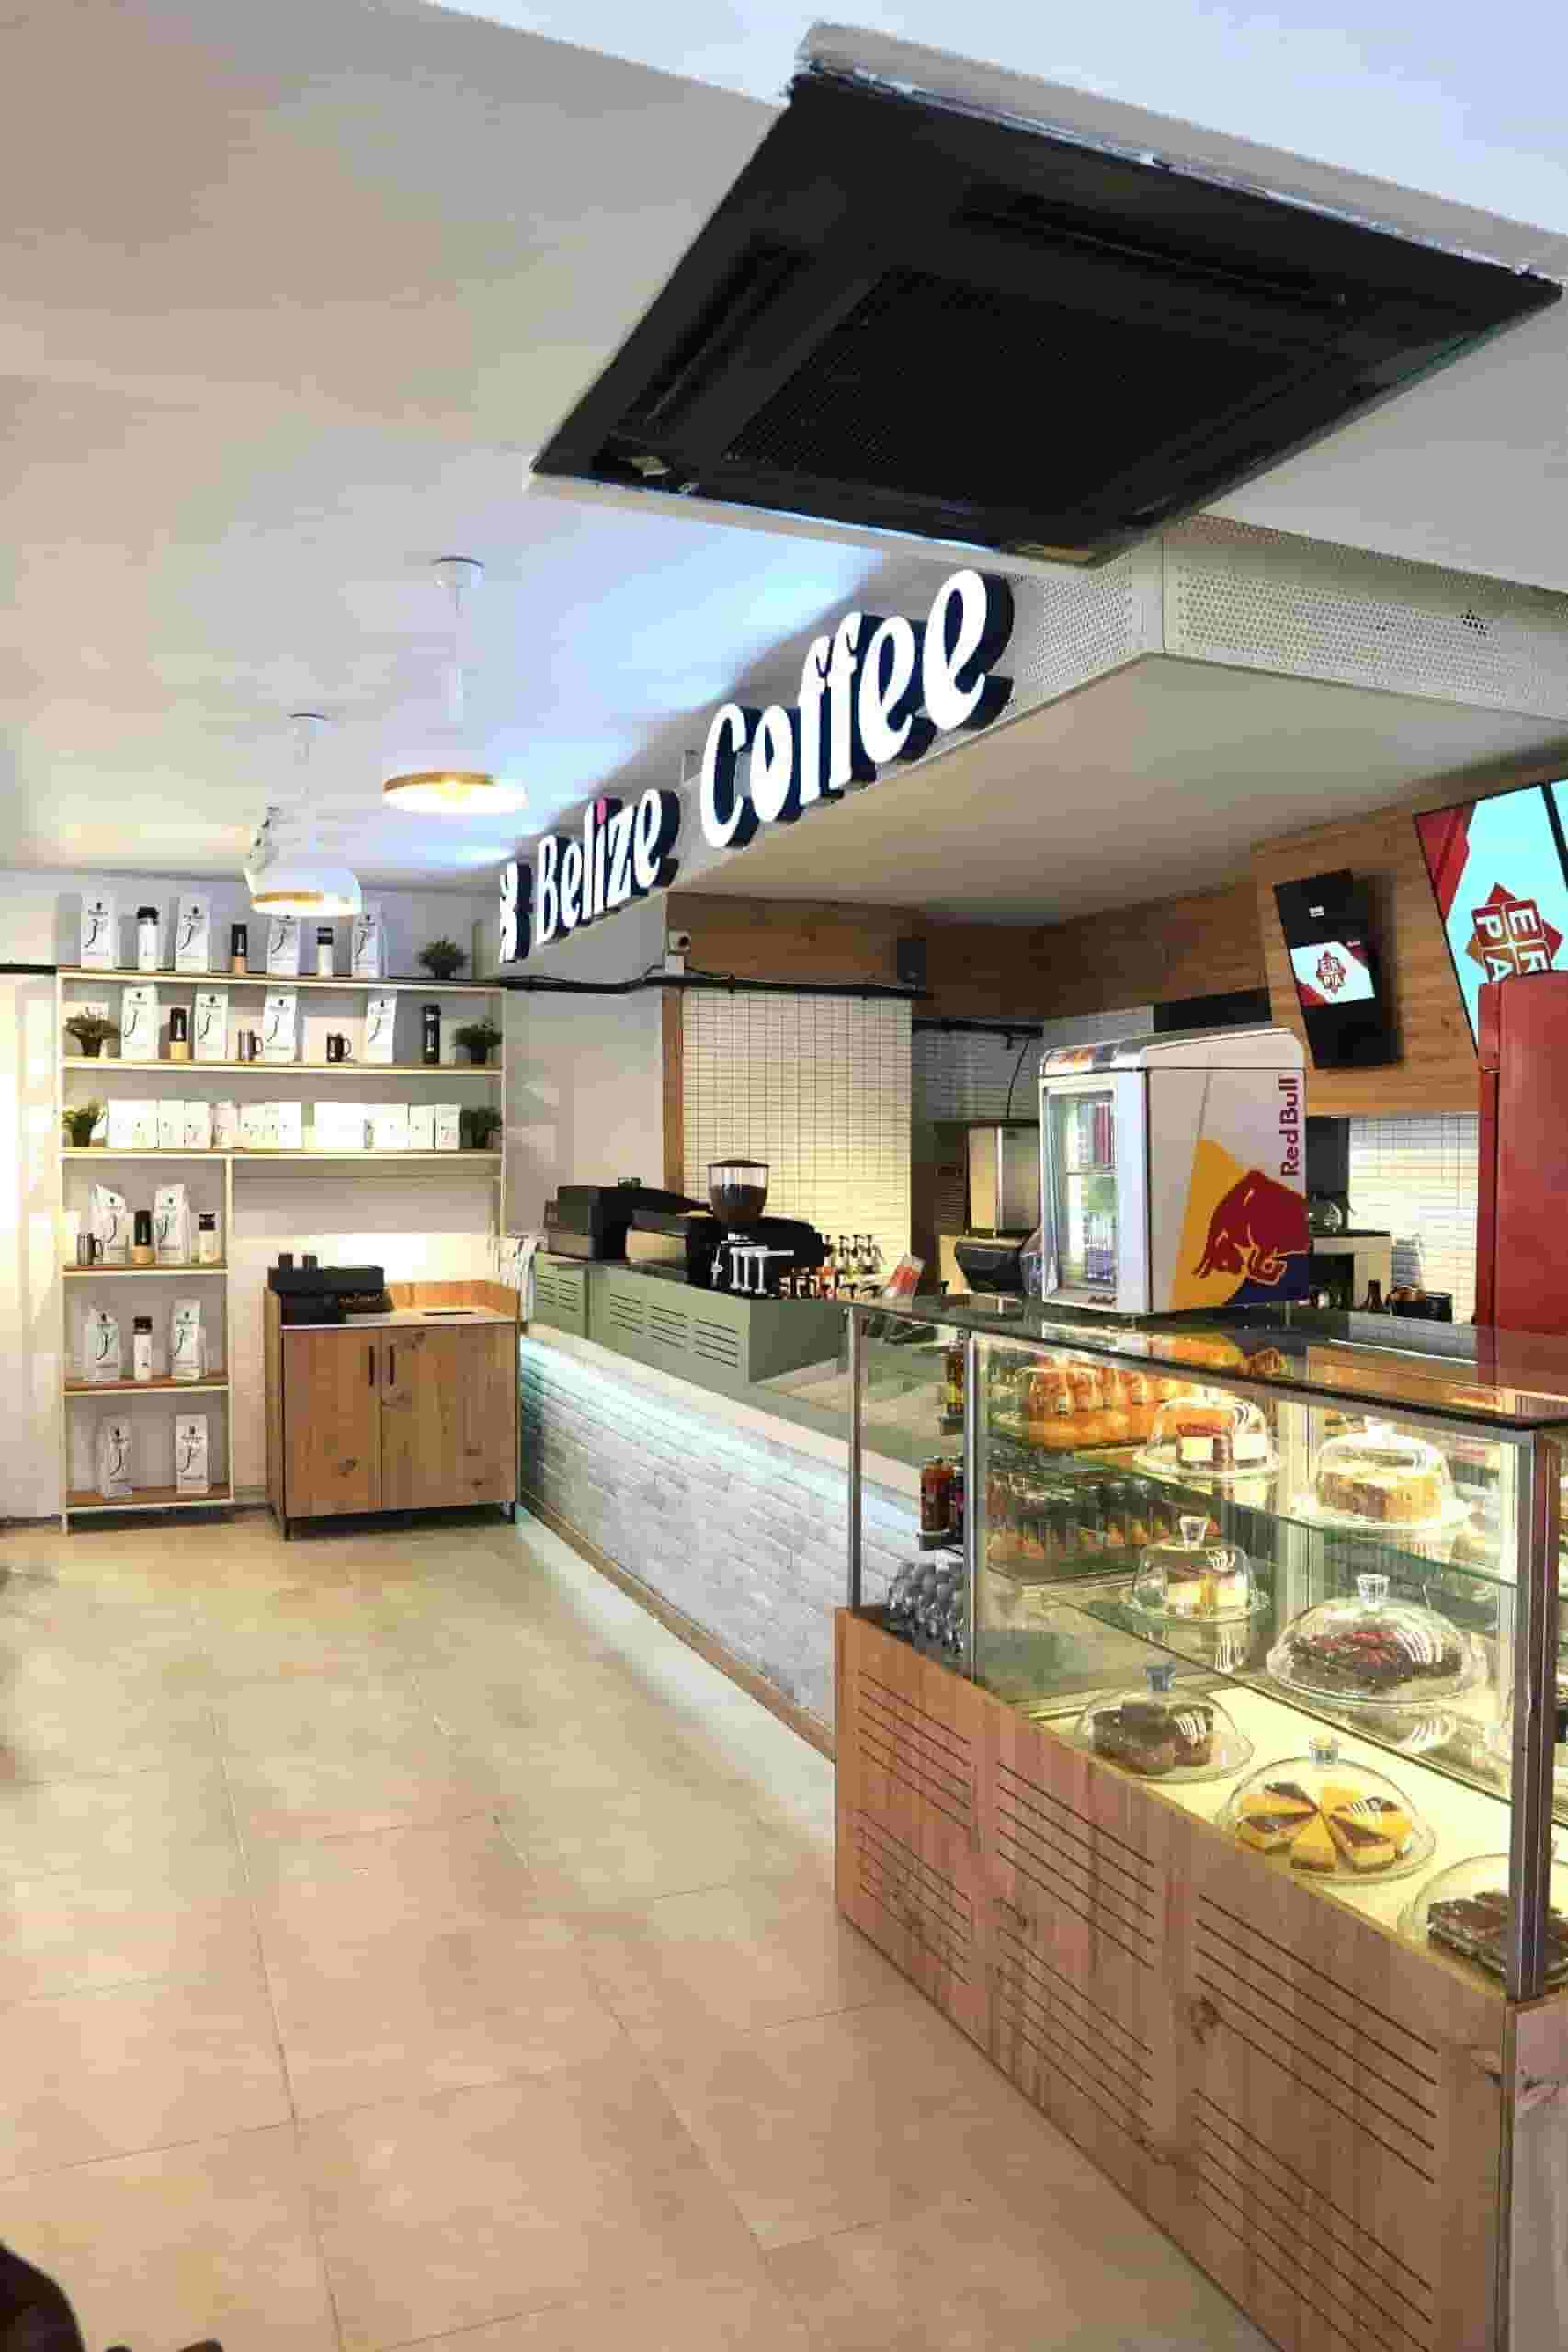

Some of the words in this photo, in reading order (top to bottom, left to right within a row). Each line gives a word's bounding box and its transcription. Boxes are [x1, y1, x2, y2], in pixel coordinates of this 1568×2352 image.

[536, 788, 664, 946] Belize
[699, 568, 989, 848] Coffee
[1278, 1077, 1299, 1125] Bull
[1278, 1130, 1300, 1177] Red
